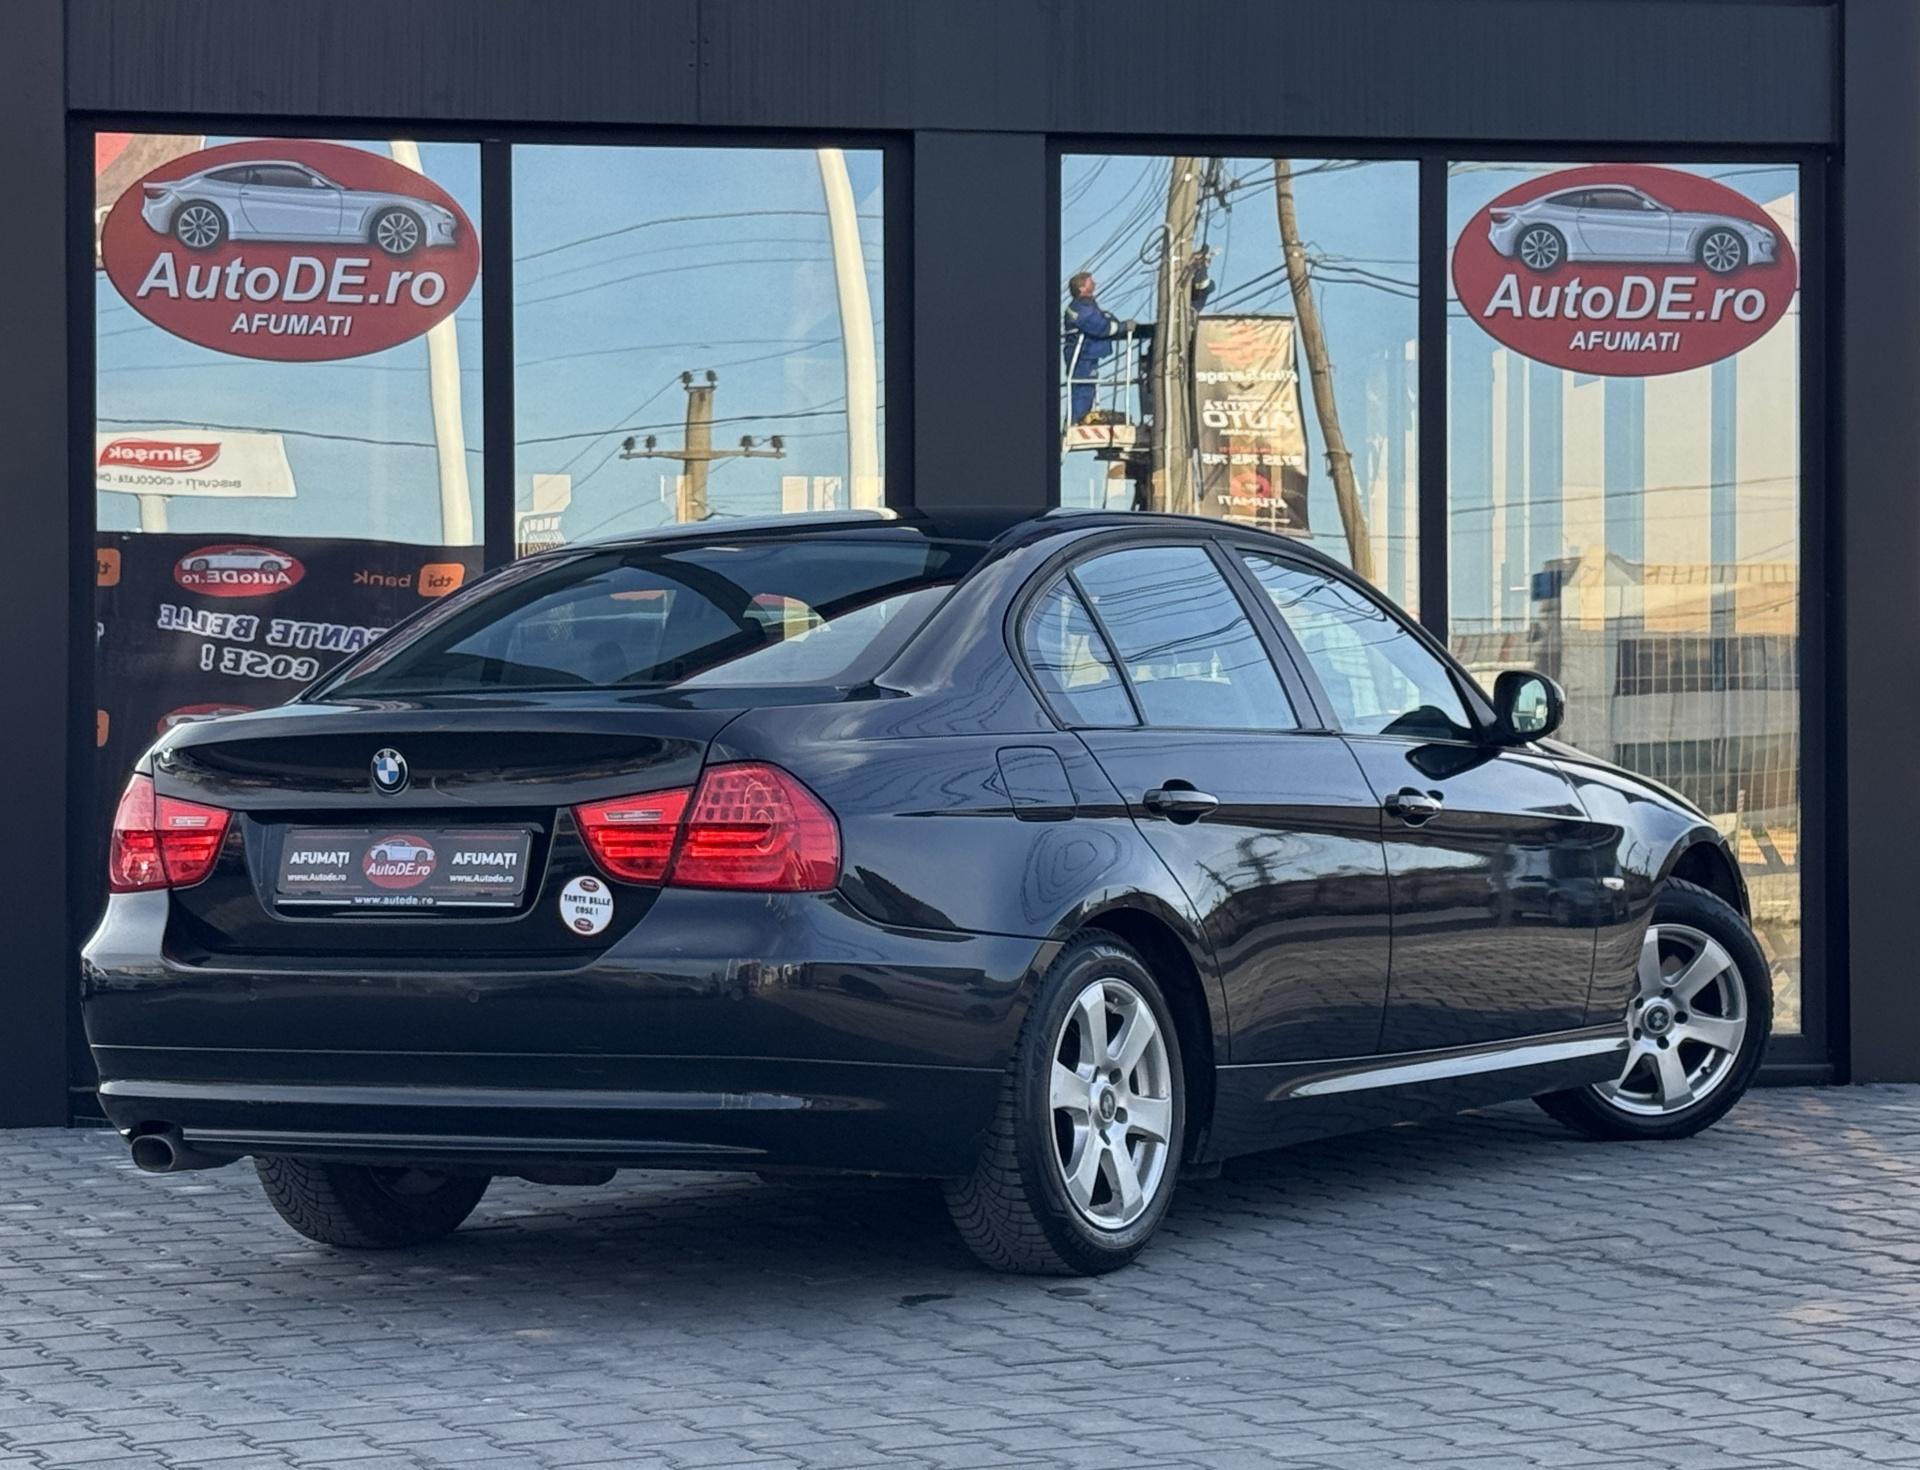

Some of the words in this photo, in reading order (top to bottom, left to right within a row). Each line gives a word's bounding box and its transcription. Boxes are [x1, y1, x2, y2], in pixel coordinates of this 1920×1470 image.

[137, 252, 446, 306] AutoDE.ro
[1483, 273, 1767, 322] AutoDE.ro
[230, 313, 353, 336] AFUMATI
[1569, 331, 1681, 352] AFUMATI
[366, 862, 431, 876] AutoDE.ro
